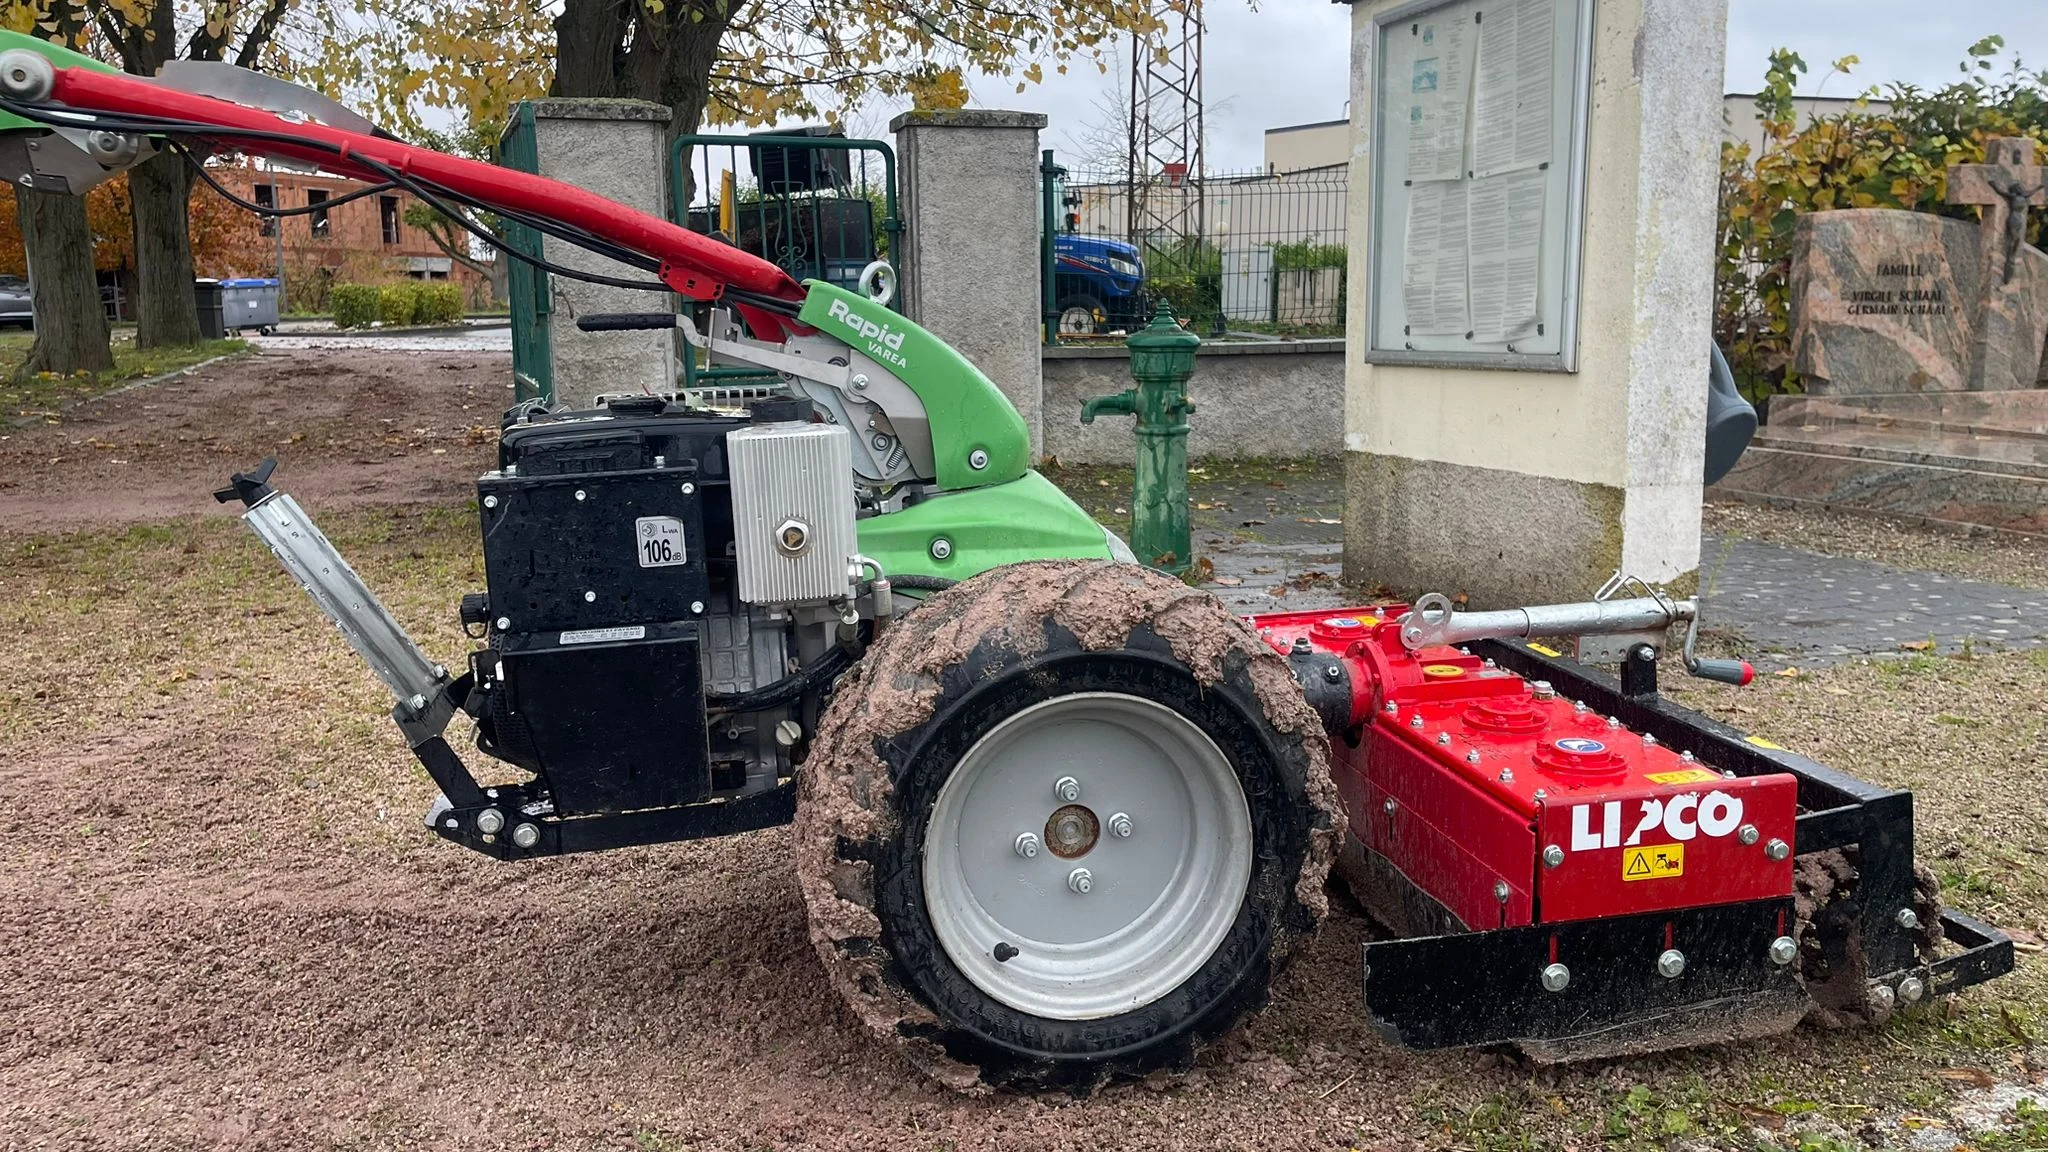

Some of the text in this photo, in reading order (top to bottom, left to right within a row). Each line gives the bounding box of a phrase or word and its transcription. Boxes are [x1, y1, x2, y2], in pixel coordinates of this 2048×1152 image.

[828, 298, 905, 351] Rapid
[867, 341, 907, 369] VAREA
[644, 539, 682, 563] 106 dB
[1571, 790, 1744, 851] LIPCO
